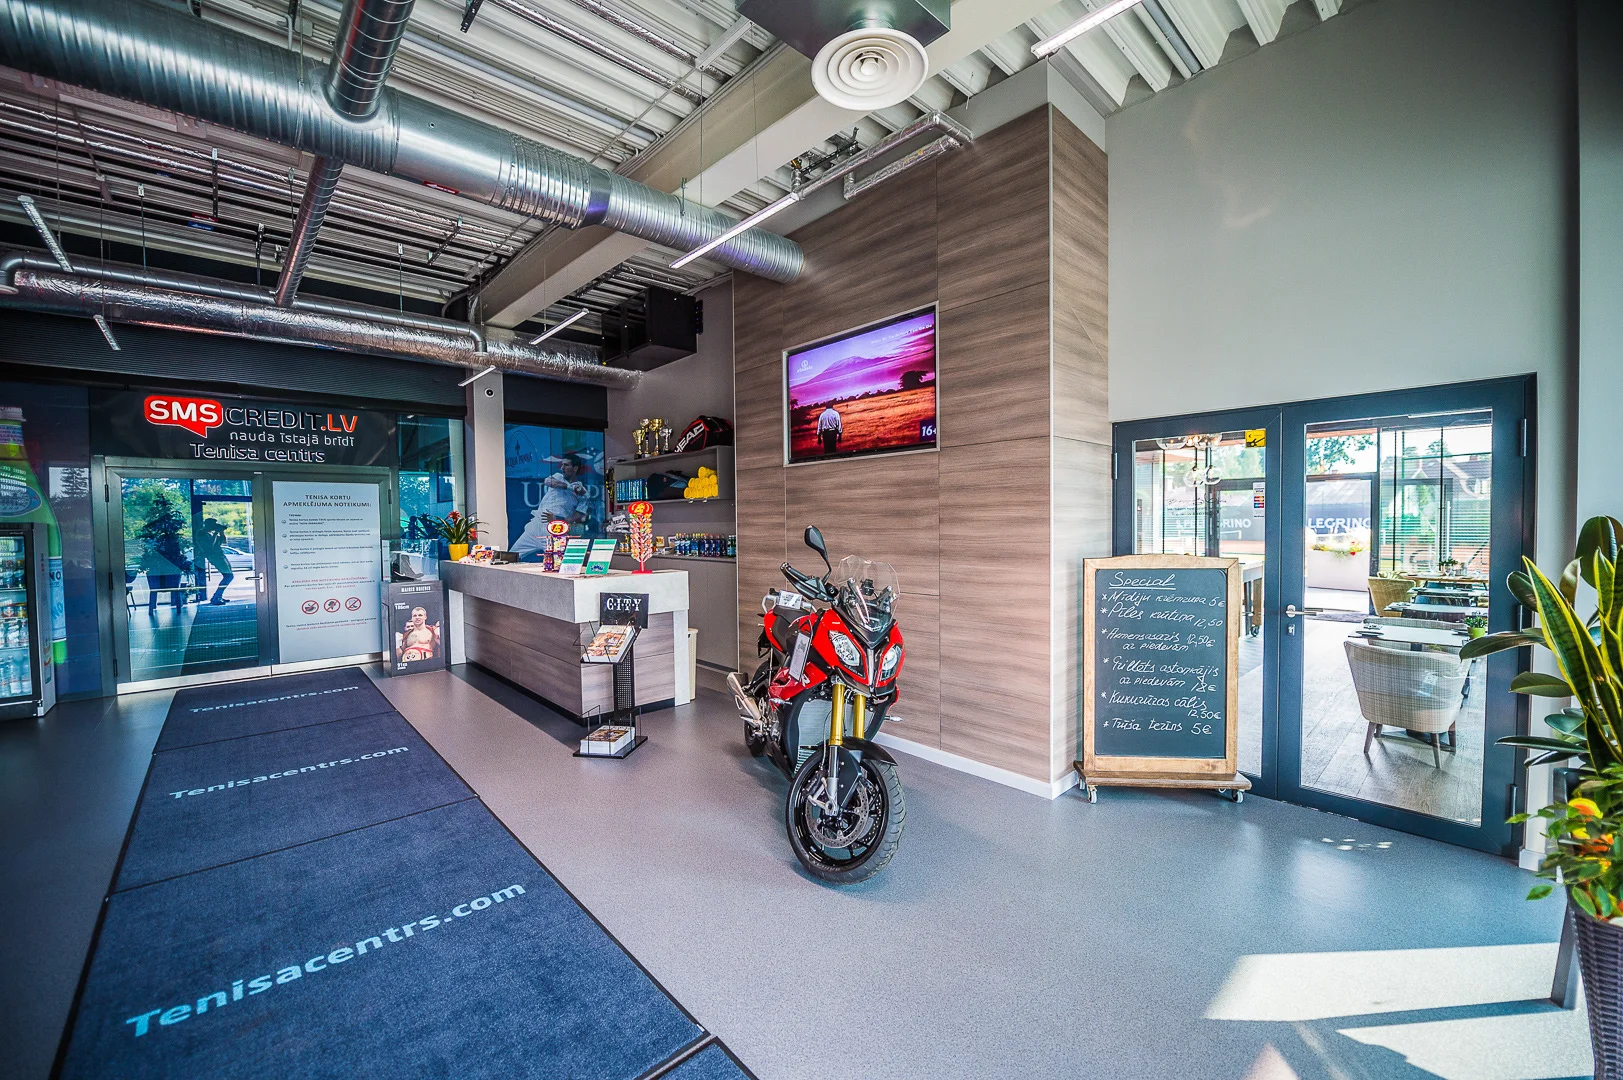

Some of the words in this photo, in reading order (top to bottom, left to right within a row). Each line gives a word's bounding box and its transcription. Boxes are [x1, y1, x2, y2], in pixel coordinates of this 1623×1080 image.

[230, 431, 275, 443] nauda
[190, 442, 260, 460] Tenisa
[264, 449, 326, 463] centrs
[1108, 571, 1176, 587] Special
[1193, 618, 1224, 629] 12,50
[189, 685, 359, 714] Tenisacentrs.com
[1187, 709, 1222, 720] 12,50€
[1190, 723, 1213, 735] 5€
[169, 744, 409, 799] Tenisacentrs.com
[126, 882, 526, 1037] Tenisacentrs.com
